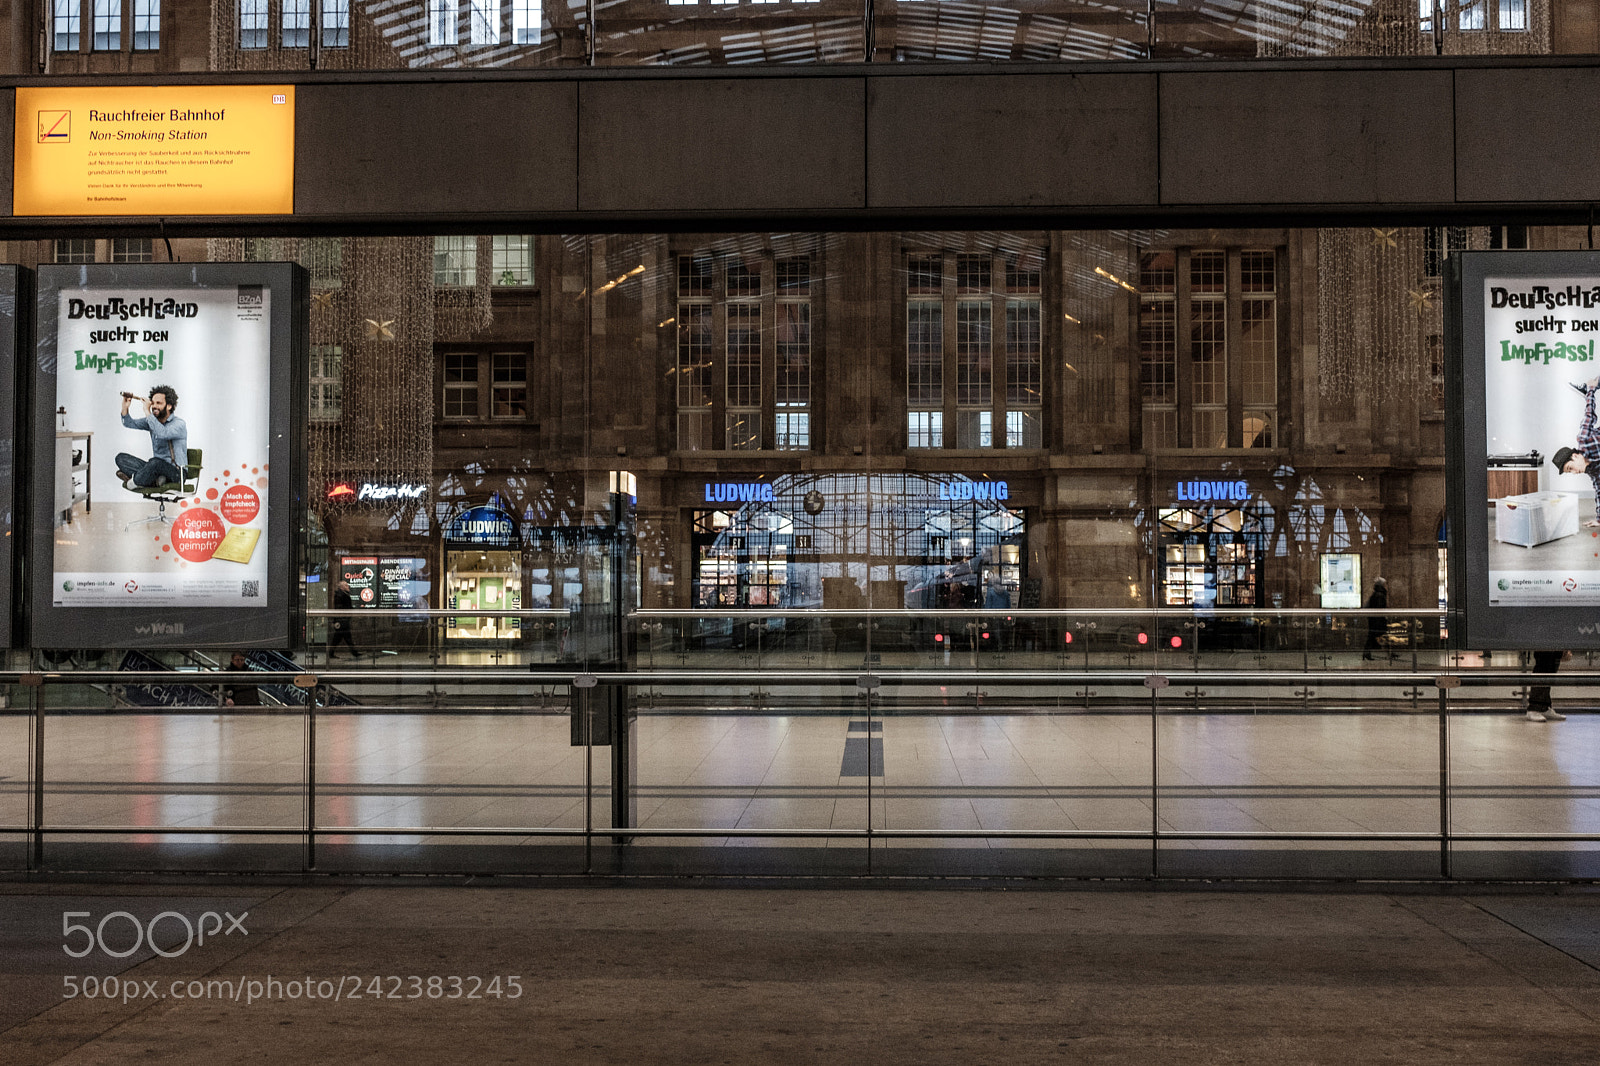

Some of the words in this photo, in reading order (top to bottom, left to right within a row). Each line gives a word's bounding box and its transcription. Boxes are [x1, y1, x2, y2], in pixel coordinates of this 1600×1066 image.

[89, 109, 165, 122] Rauchfreier
[170, 108, 226, 122] Bahnhof
[89, 130, 165, 142] Non-Smoking
[168, 129, 208, 140] Station
[98, 150, 137, 158] Verbesserung
[359, 484, 397, 500] Pizza
[398, 483, 427, 498] Hut
[1177, 480, 1252, 501] LUDWIG.
[184, 518, 213, 530] Gegen
[178, 529, 218, 539] Masern
[179, 541, 218, 552] geimpft?
